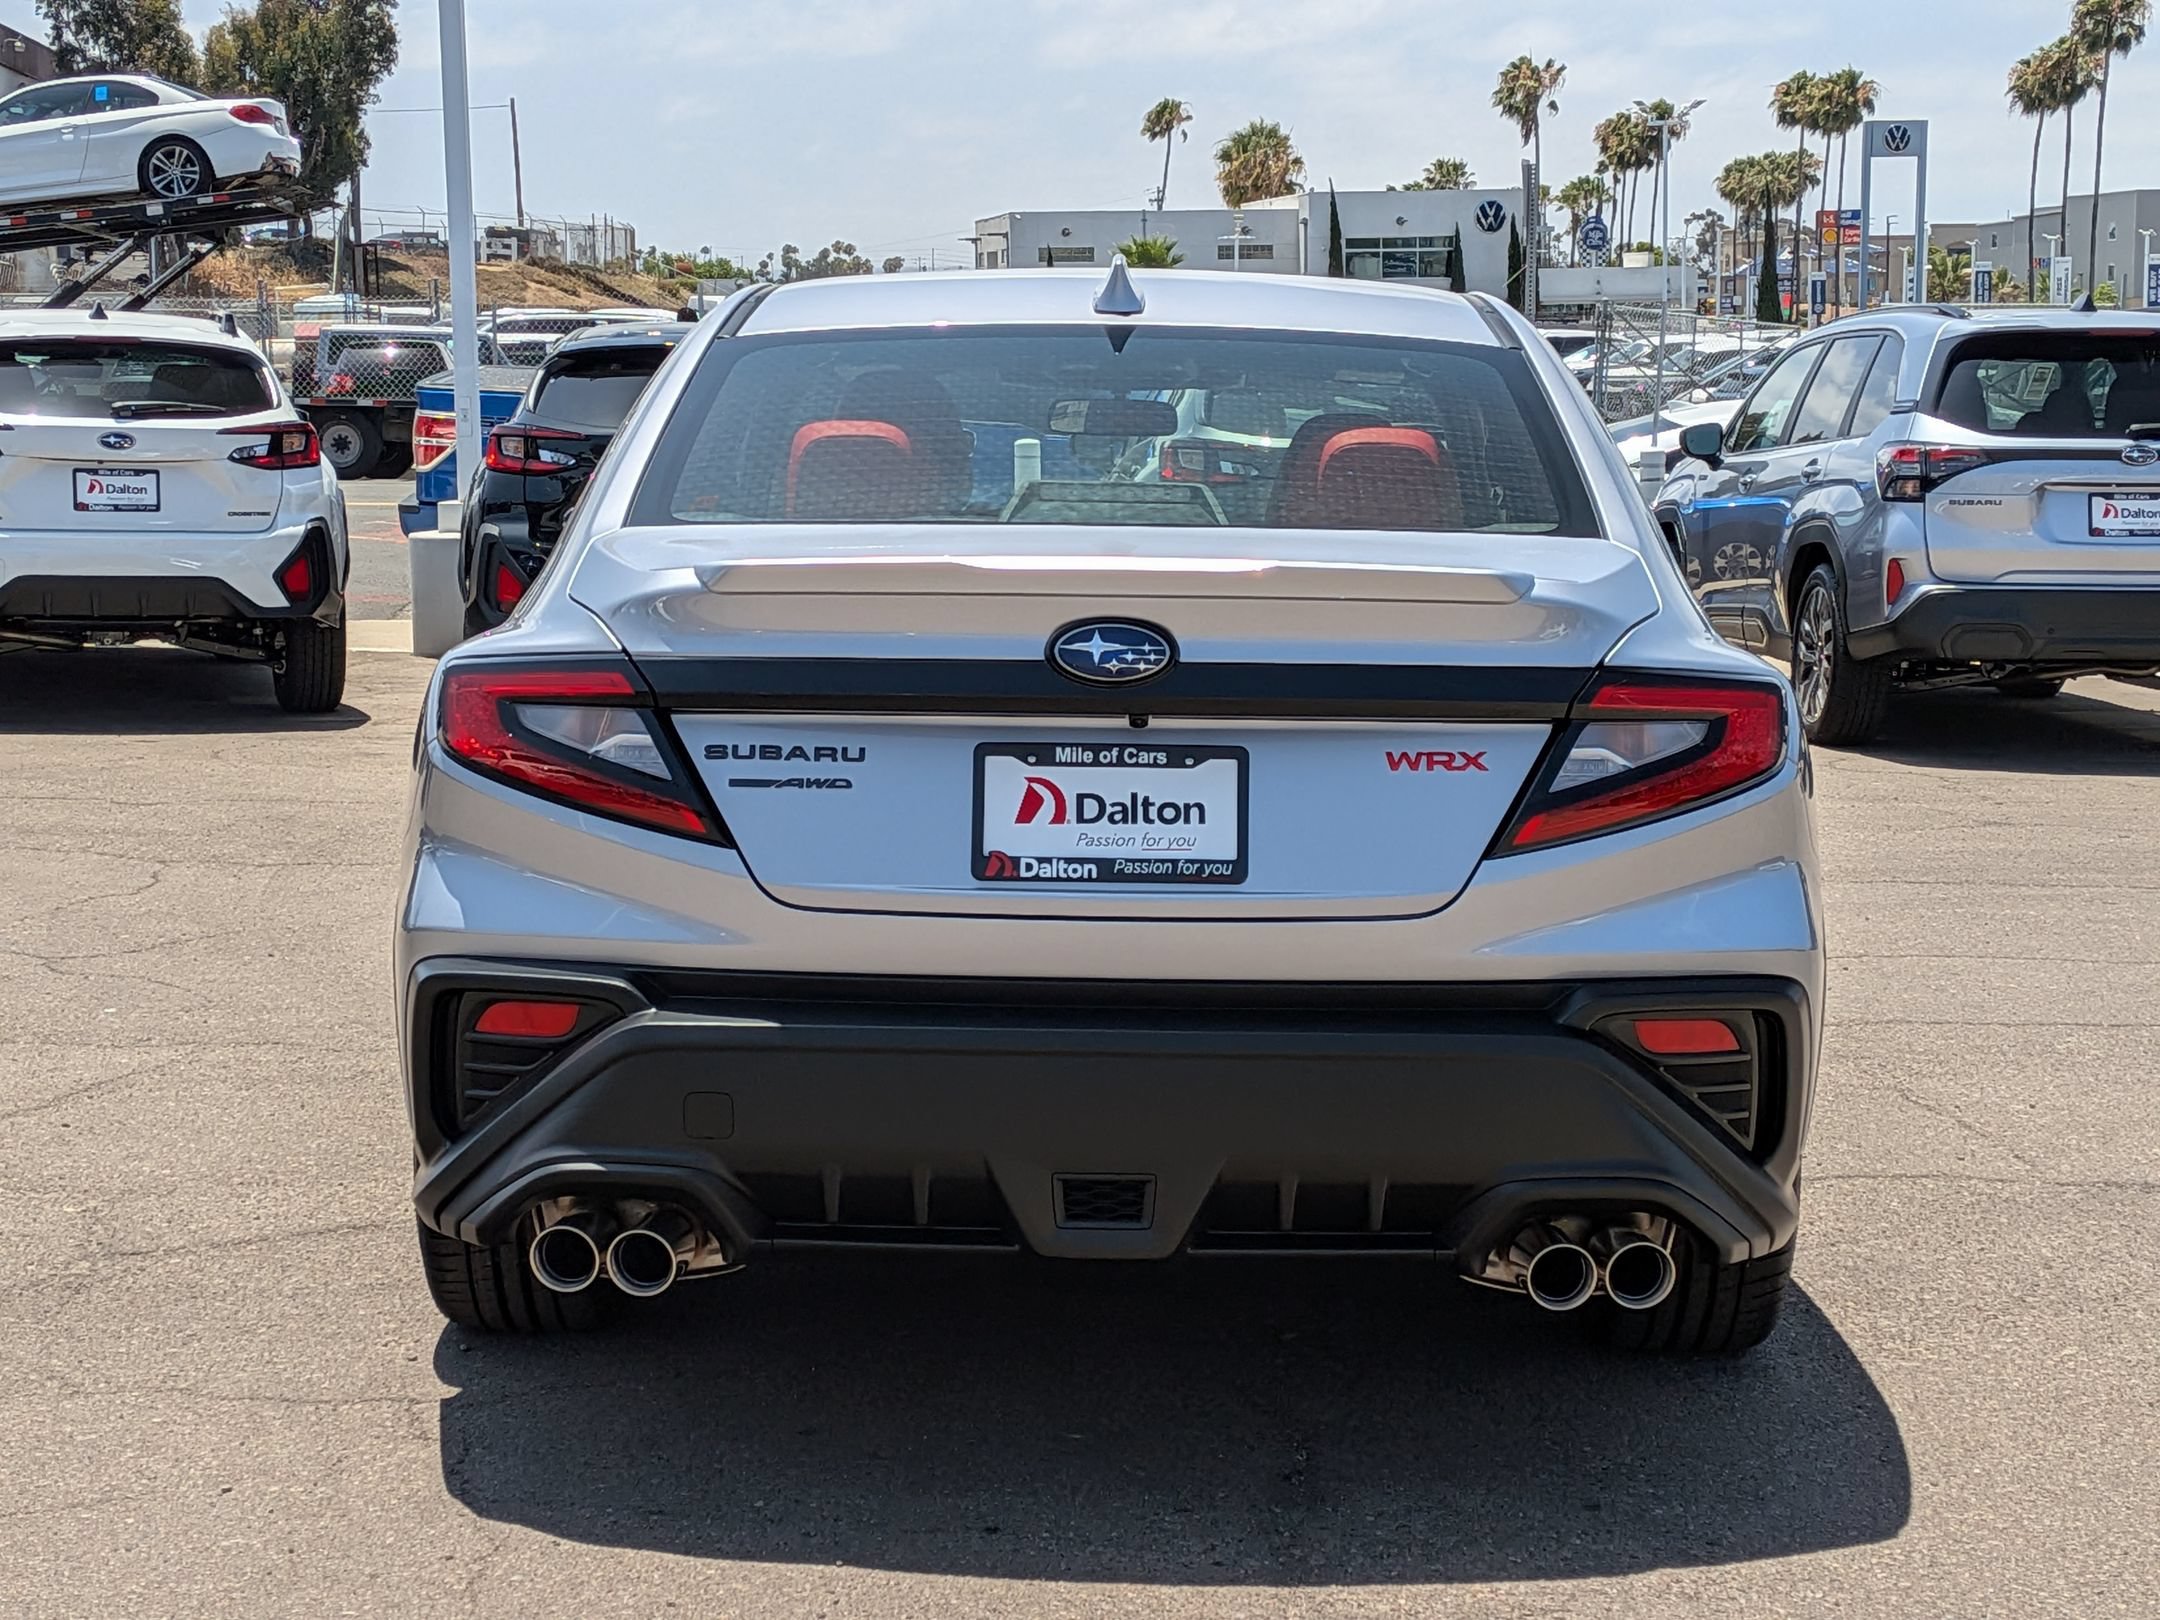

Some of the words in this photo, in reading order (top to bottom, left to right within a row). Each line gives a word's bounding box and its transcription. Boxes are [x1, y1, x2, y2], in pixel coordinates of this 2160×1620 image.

[106, 483, 147, 495] Dalton
[704, 744, 867, 763] SUBARU
[1055, 747, 1094, 764] Mile
[1099, 747, 1118, 764] of
[1123, 748, 1168, 765] Cars
[1385, 751, 1489, 771] WRX
[770, 777, 853, 790] AWD
[1075, 792, 1206, 826] Dalton
[1076, 832, 1136, 848] Passion
[1141, 832, 1165, 848] for
[1166, 835, 1197, 850] you
[1019, 857, 1098, 879] Dalton
[1113, 859, 1174, 875] Passion
[1175, 860, 1201, 876] for
[1201, 862, 1233, 878] you
